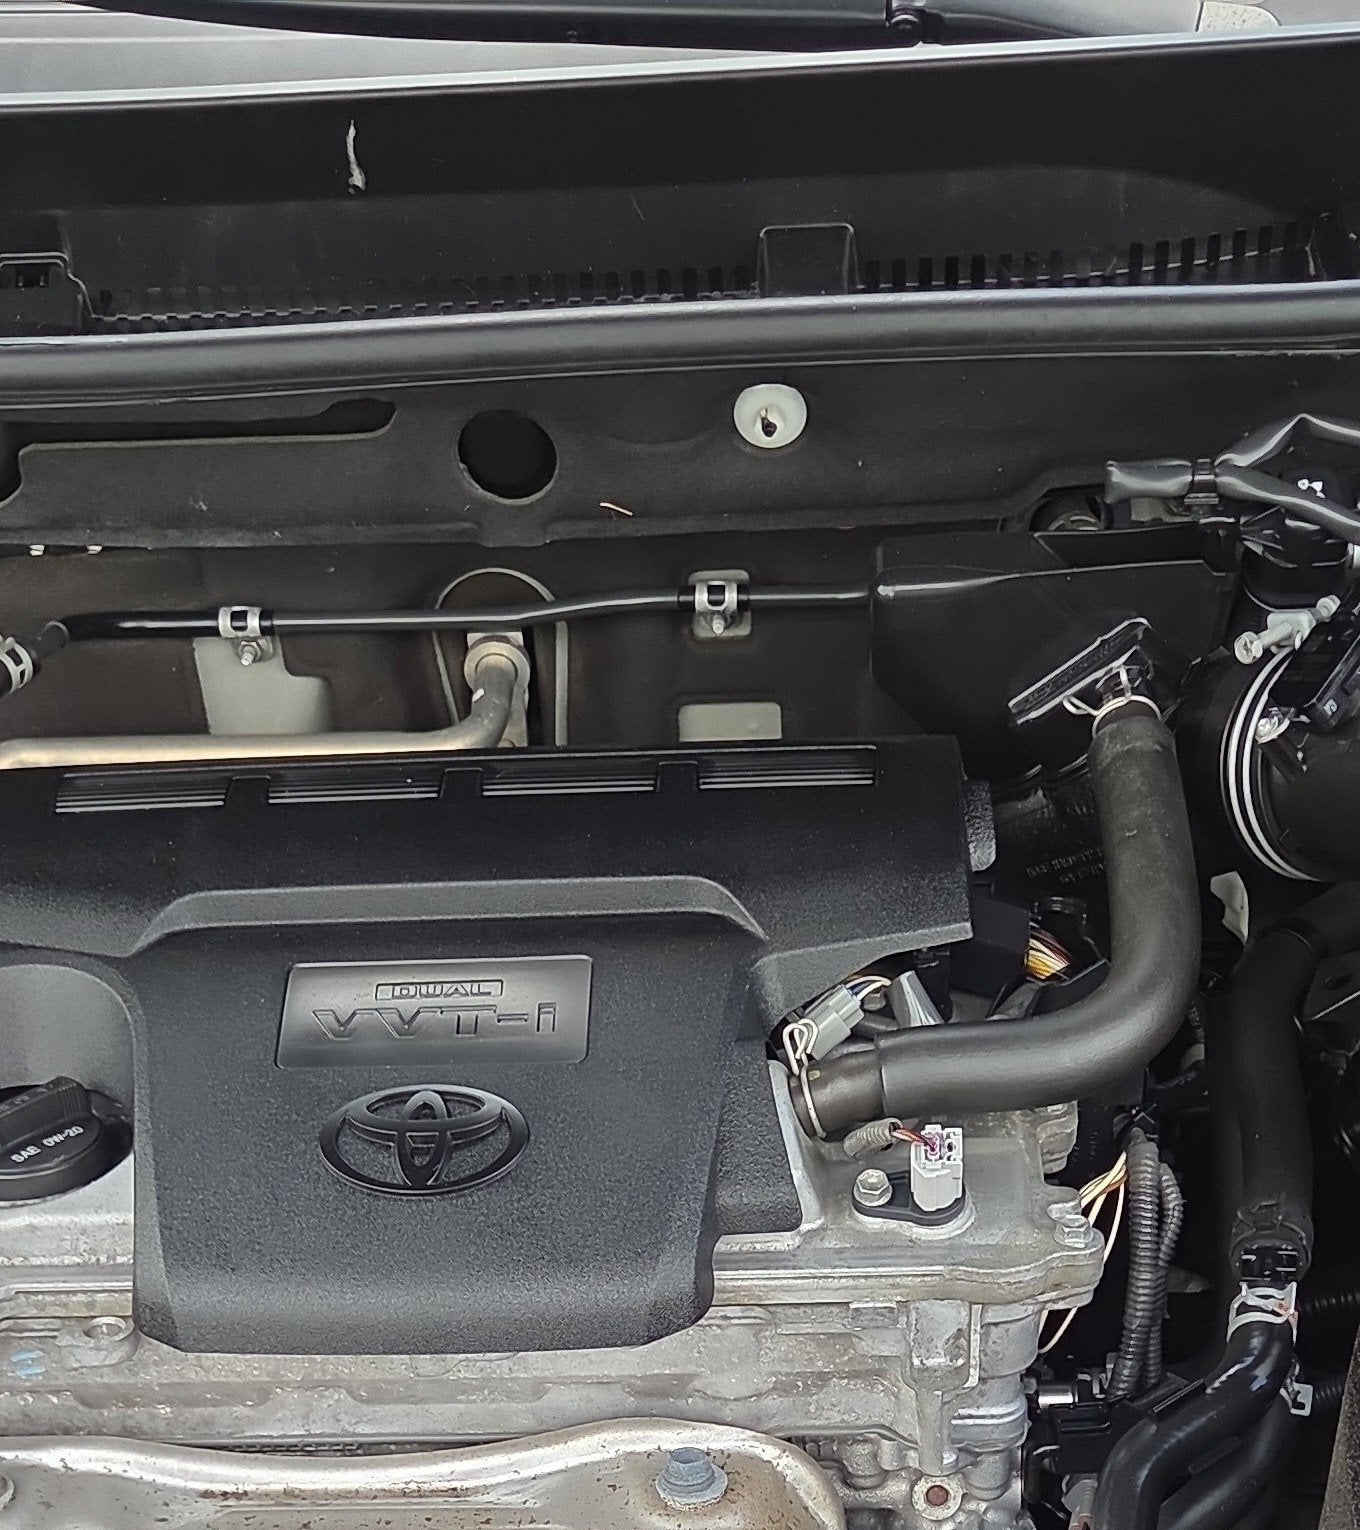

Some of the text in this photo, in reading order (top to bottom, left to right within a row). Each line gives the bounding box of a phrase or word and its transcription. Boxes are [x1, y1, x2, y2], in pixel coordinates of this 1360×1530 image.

[391, 983, 492, 999] DUAL
[10, 1125, 84, 1163] SAE 0W-20
